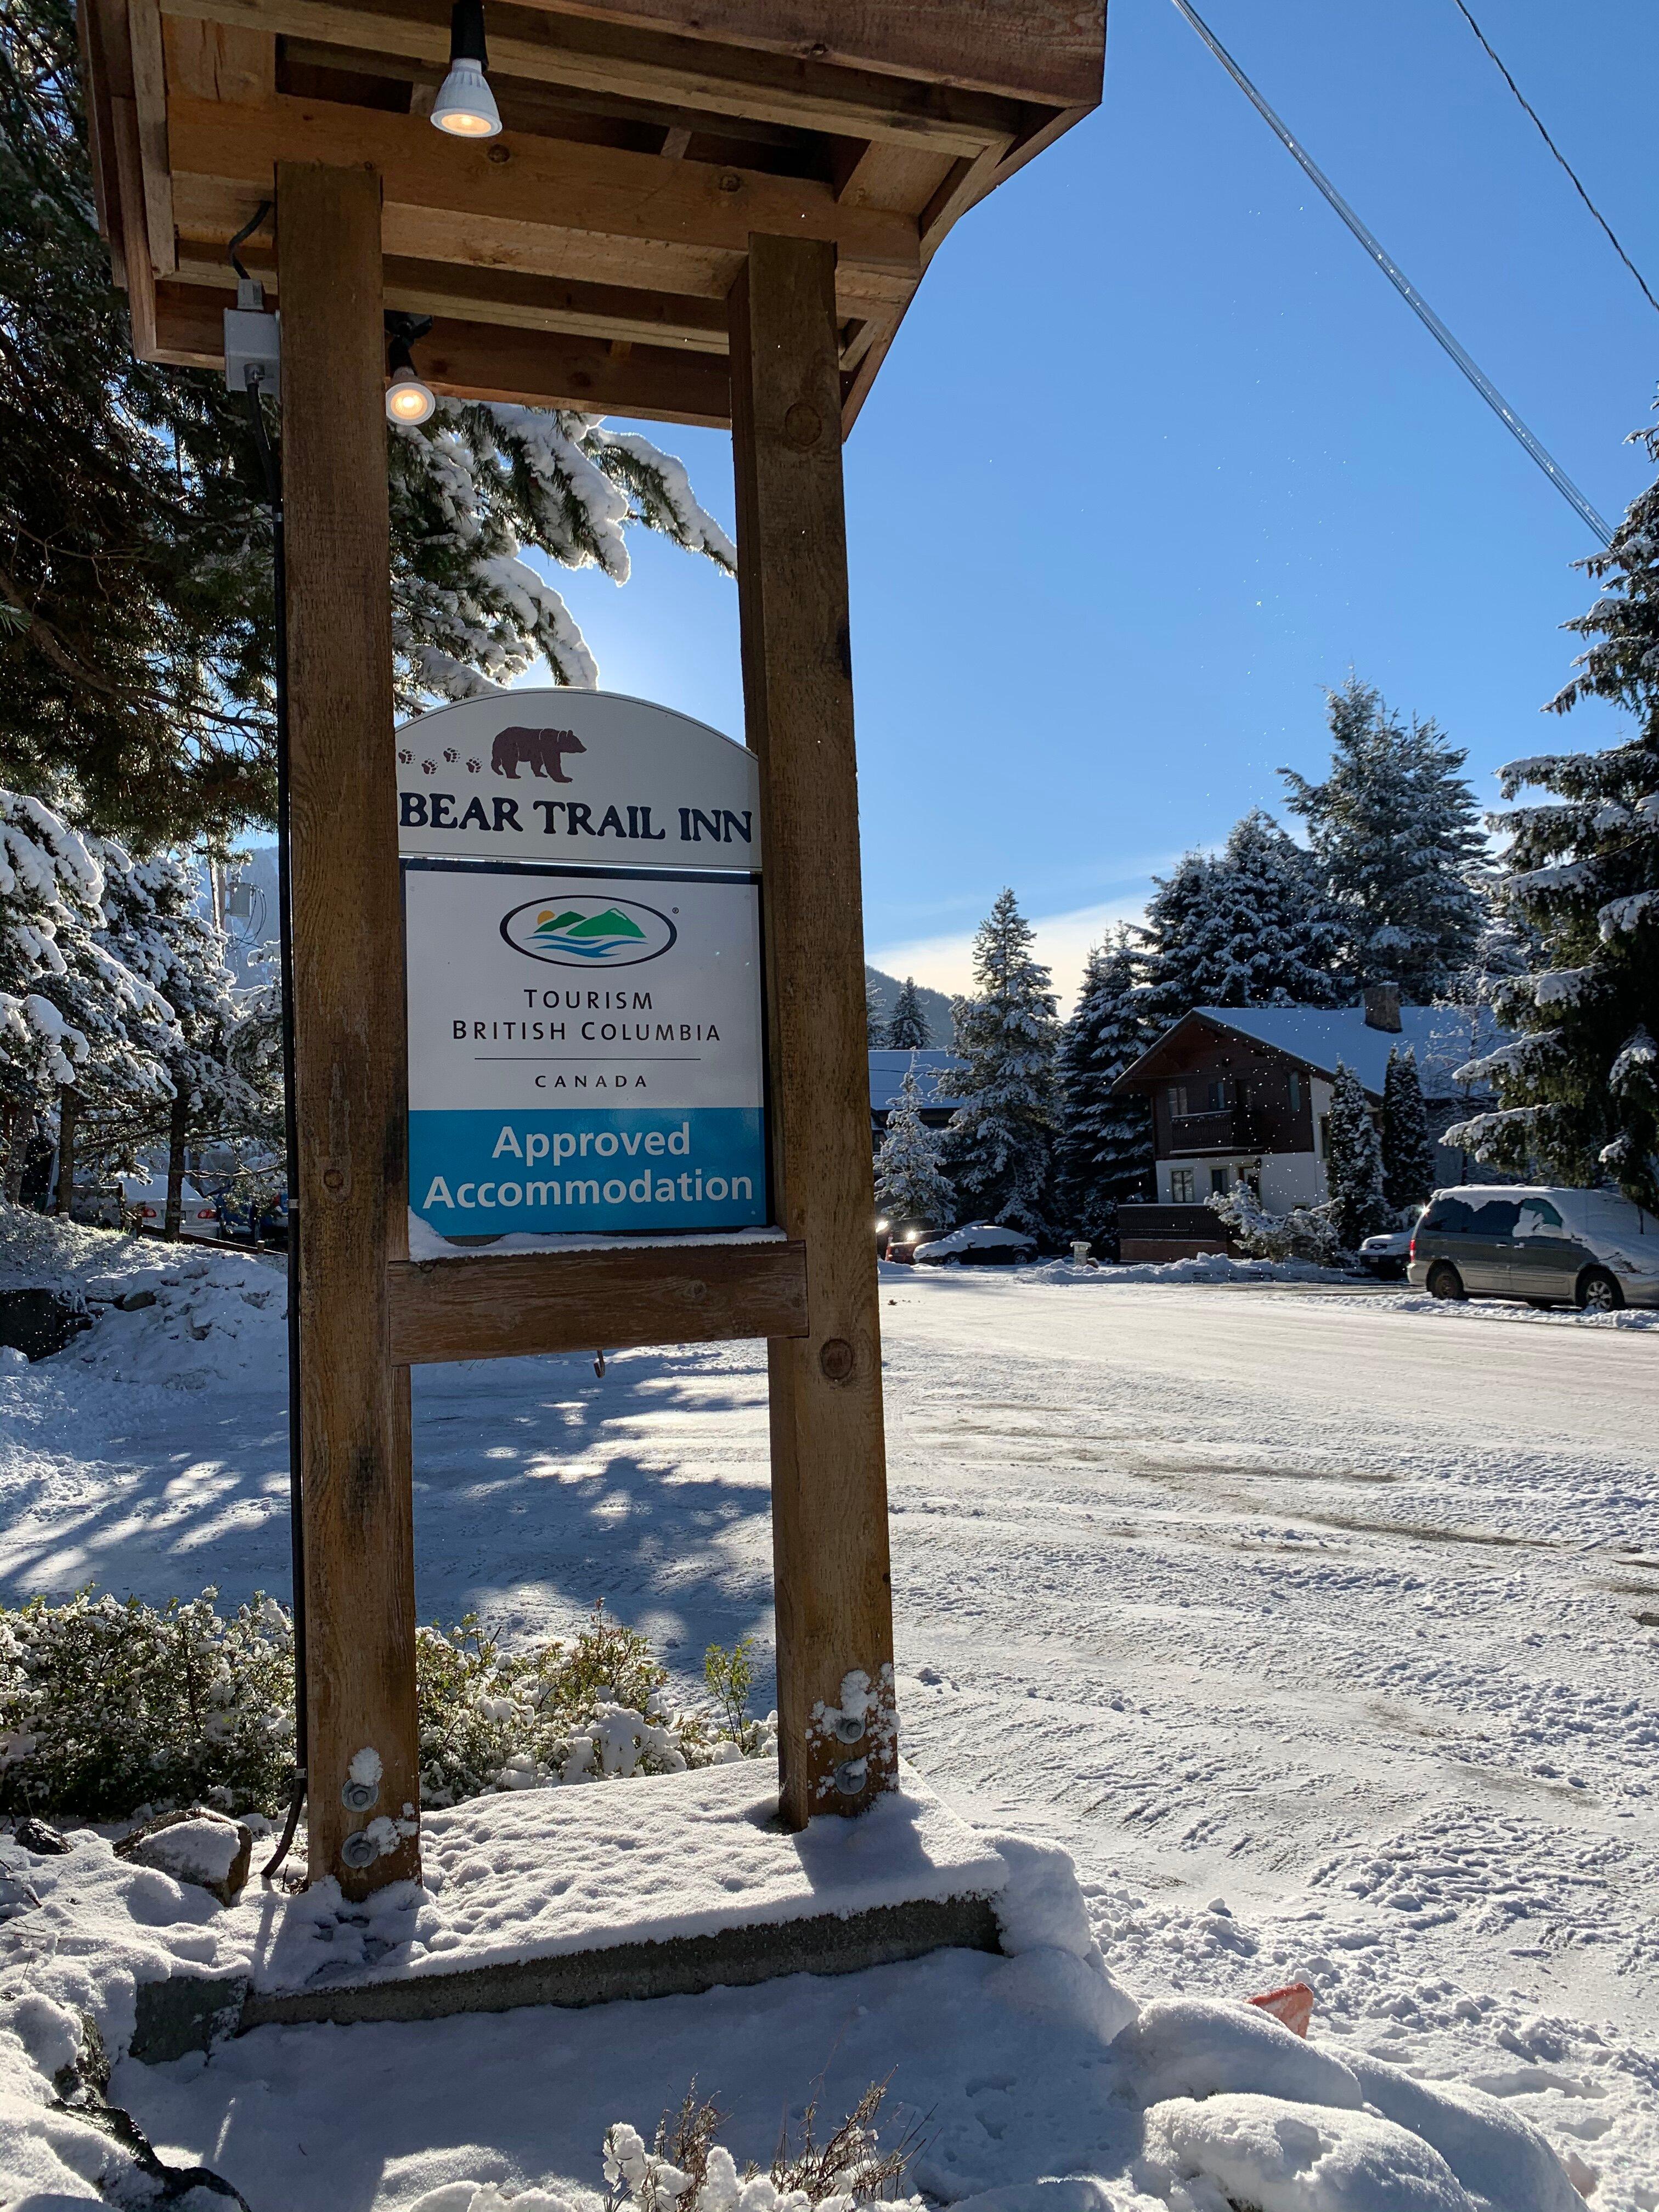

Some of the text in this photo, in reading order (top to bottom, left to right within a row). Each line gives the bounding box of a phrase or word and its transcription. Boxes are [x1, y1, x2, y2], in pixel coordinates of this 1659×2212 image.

[399, 792, 752, 843] BEAR TRAIL INN
[523, 989, 653, 1009] TOURISM
[453, 1020, 720, 1041] BRITISH COLUMBIA
[535, 1075, 647, 1088] CANADA
[492, 1121, 690, 1167] Approved
[422, 1169, 752, 1209] Accommodation
